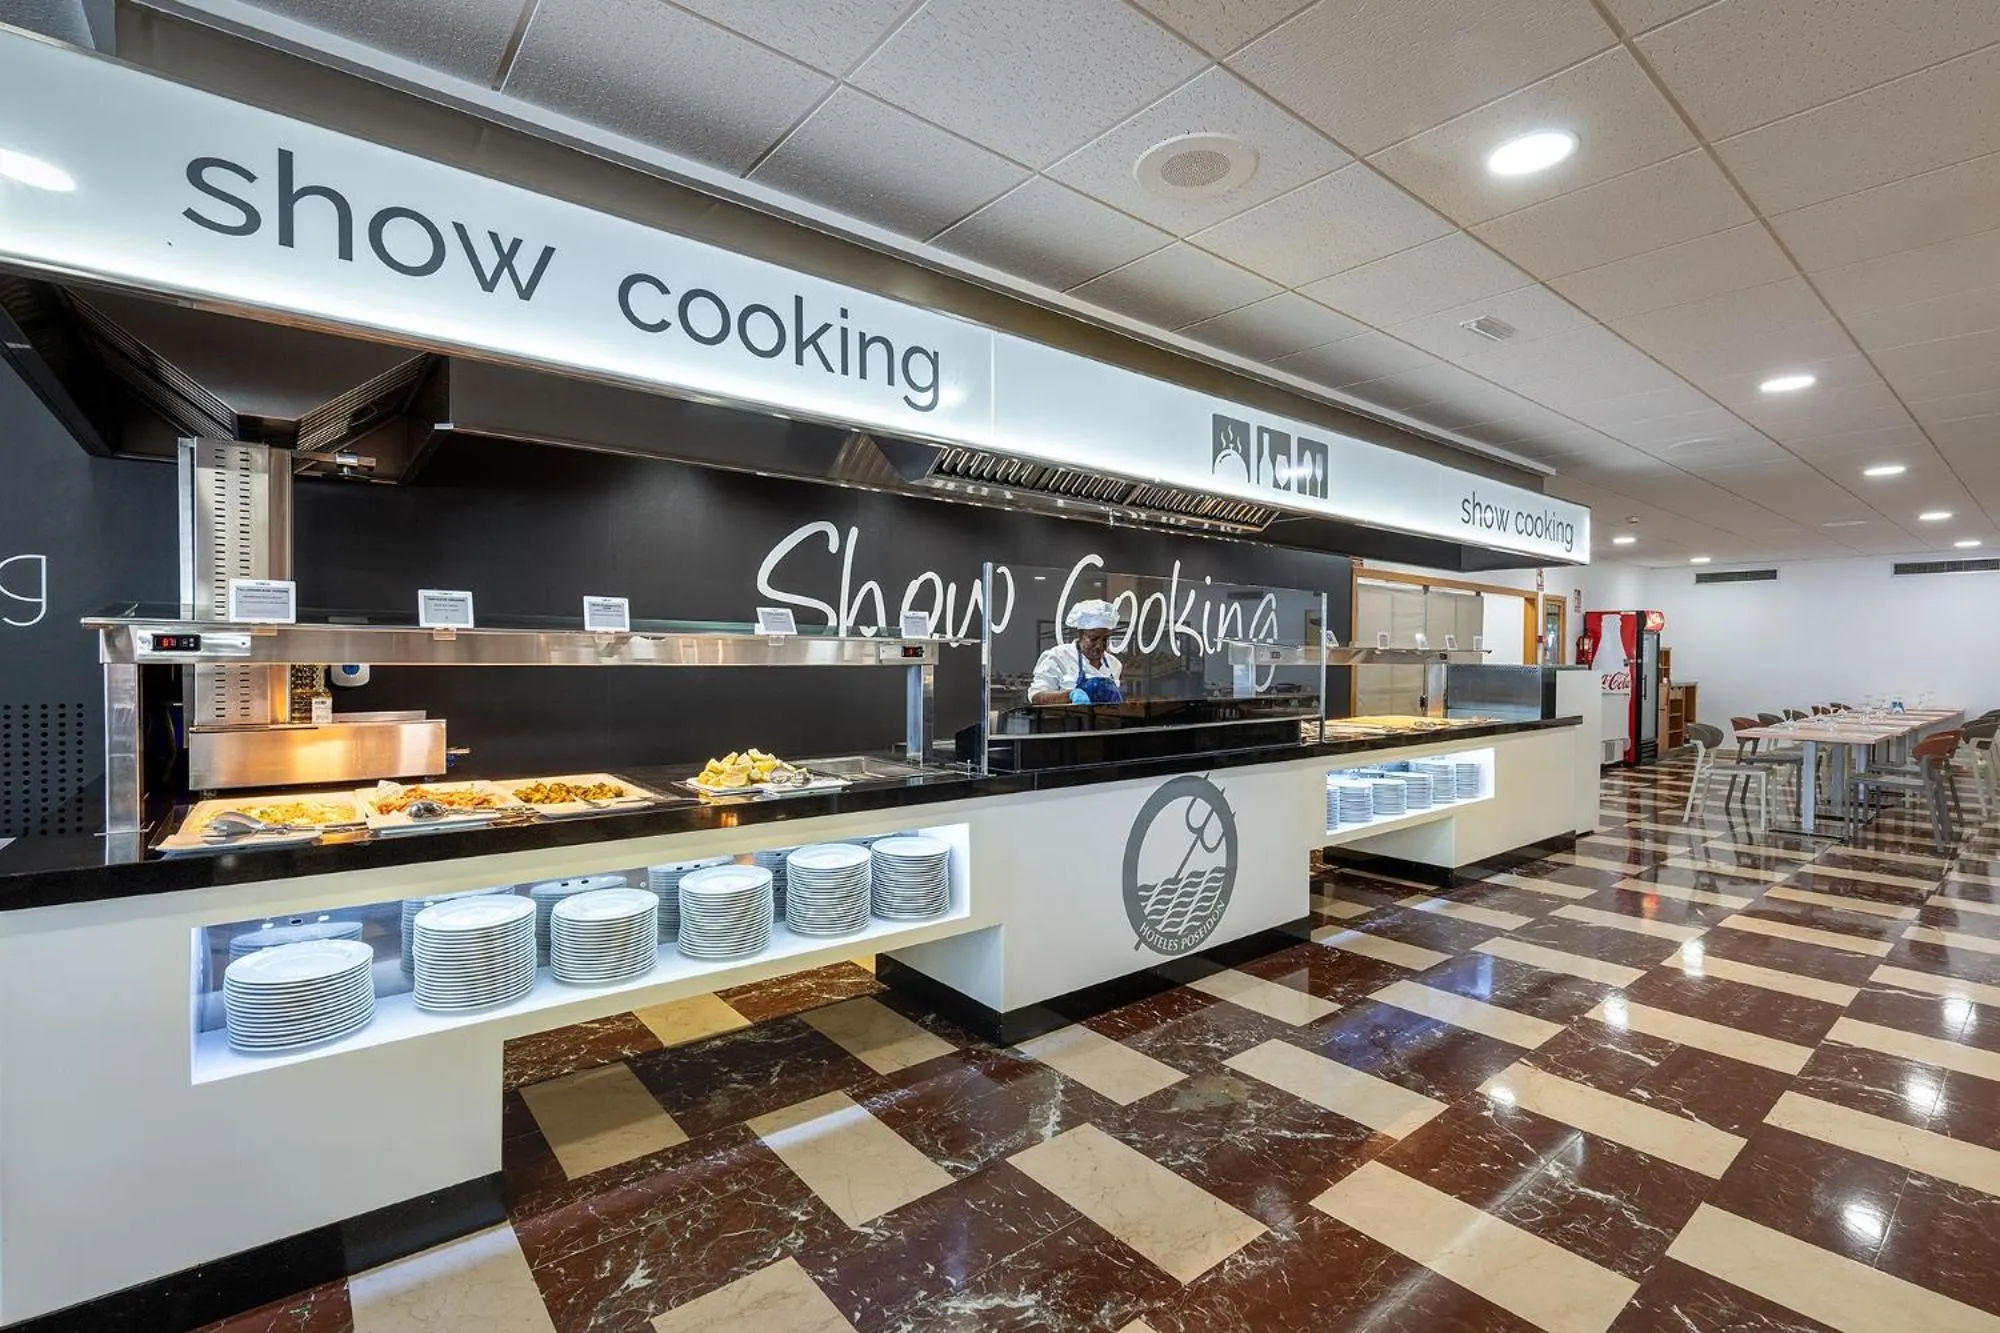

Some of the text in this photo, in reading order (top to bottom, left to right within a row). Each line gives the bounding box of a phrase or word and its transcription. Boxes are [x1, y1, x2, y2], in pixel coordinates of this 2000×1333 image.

[182, 147, 939, 413] show cooking
[1461, 491, 1574, 553] show cooking
[756, 521, 1278, 693] Show Cooking
[1139, 899, 1225, 951] HOTELES POSEIDON
